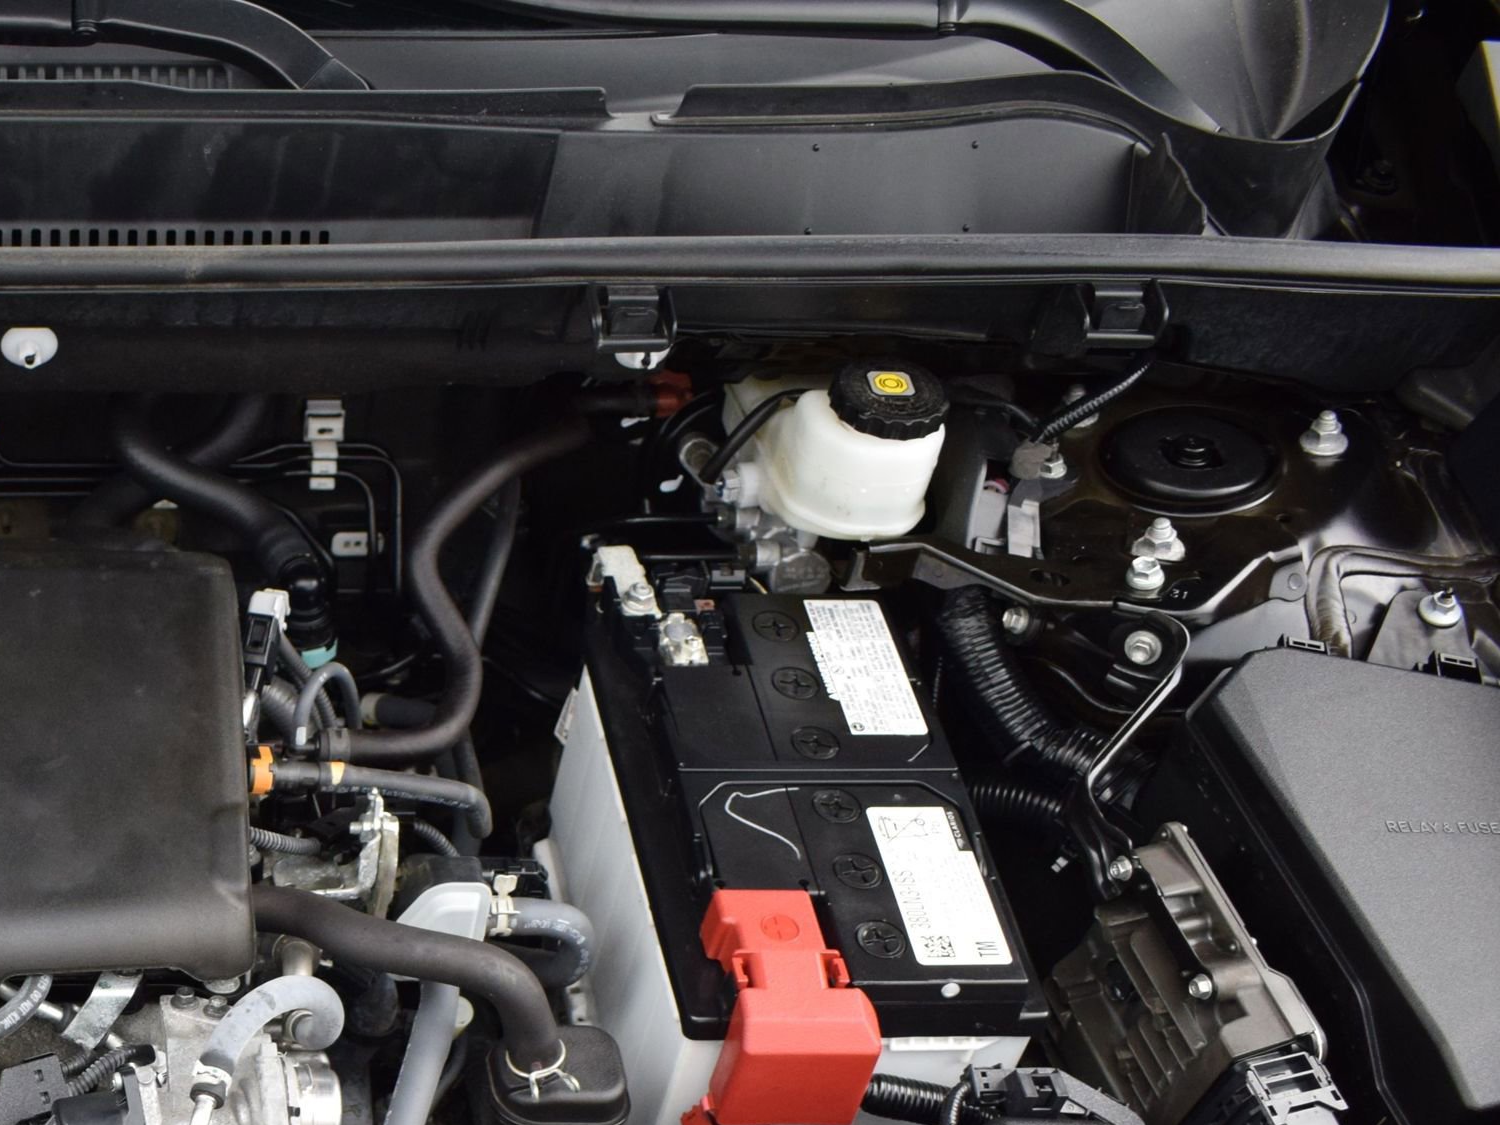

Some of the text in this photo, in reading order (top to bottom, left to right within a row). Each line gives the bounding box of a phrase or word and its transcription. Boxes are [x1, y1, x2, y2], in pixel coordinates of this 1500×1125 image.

[1386, 820, 1500, 835] RELAY & FUSE
[975, 940, 1000, 958] TM
